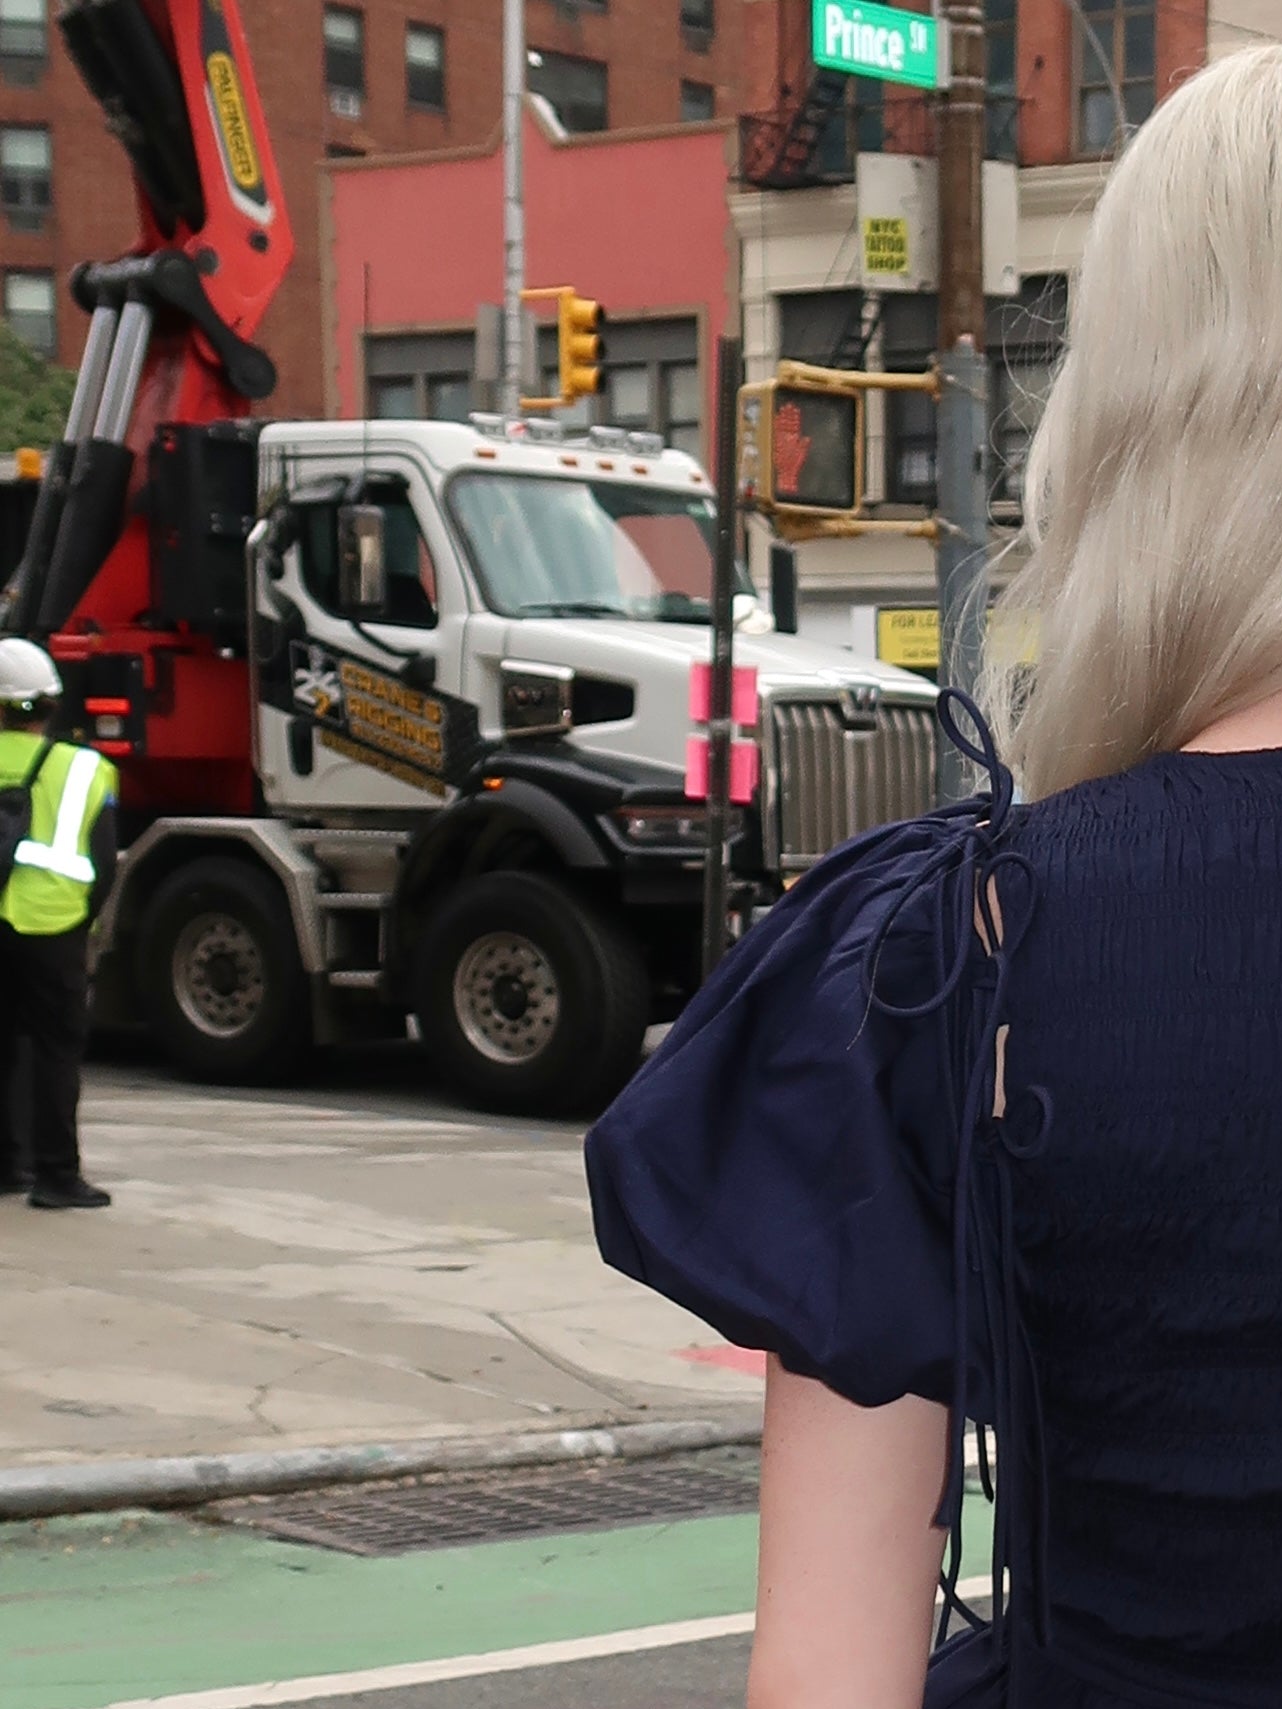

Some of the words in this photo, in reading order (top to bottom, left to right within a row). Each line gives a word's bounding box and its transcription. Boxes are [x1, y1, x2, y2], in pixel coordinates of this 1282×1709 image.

[824, 3, 905, 71] Prince
[865, 235, 906, 253] TATTOO
[870, 218, 902, 234] NYC
[866, 255, 907, 271] SHOP
[341, 661, 424, 717] CRANE
[347, 692, 442, 754] RIGGING
